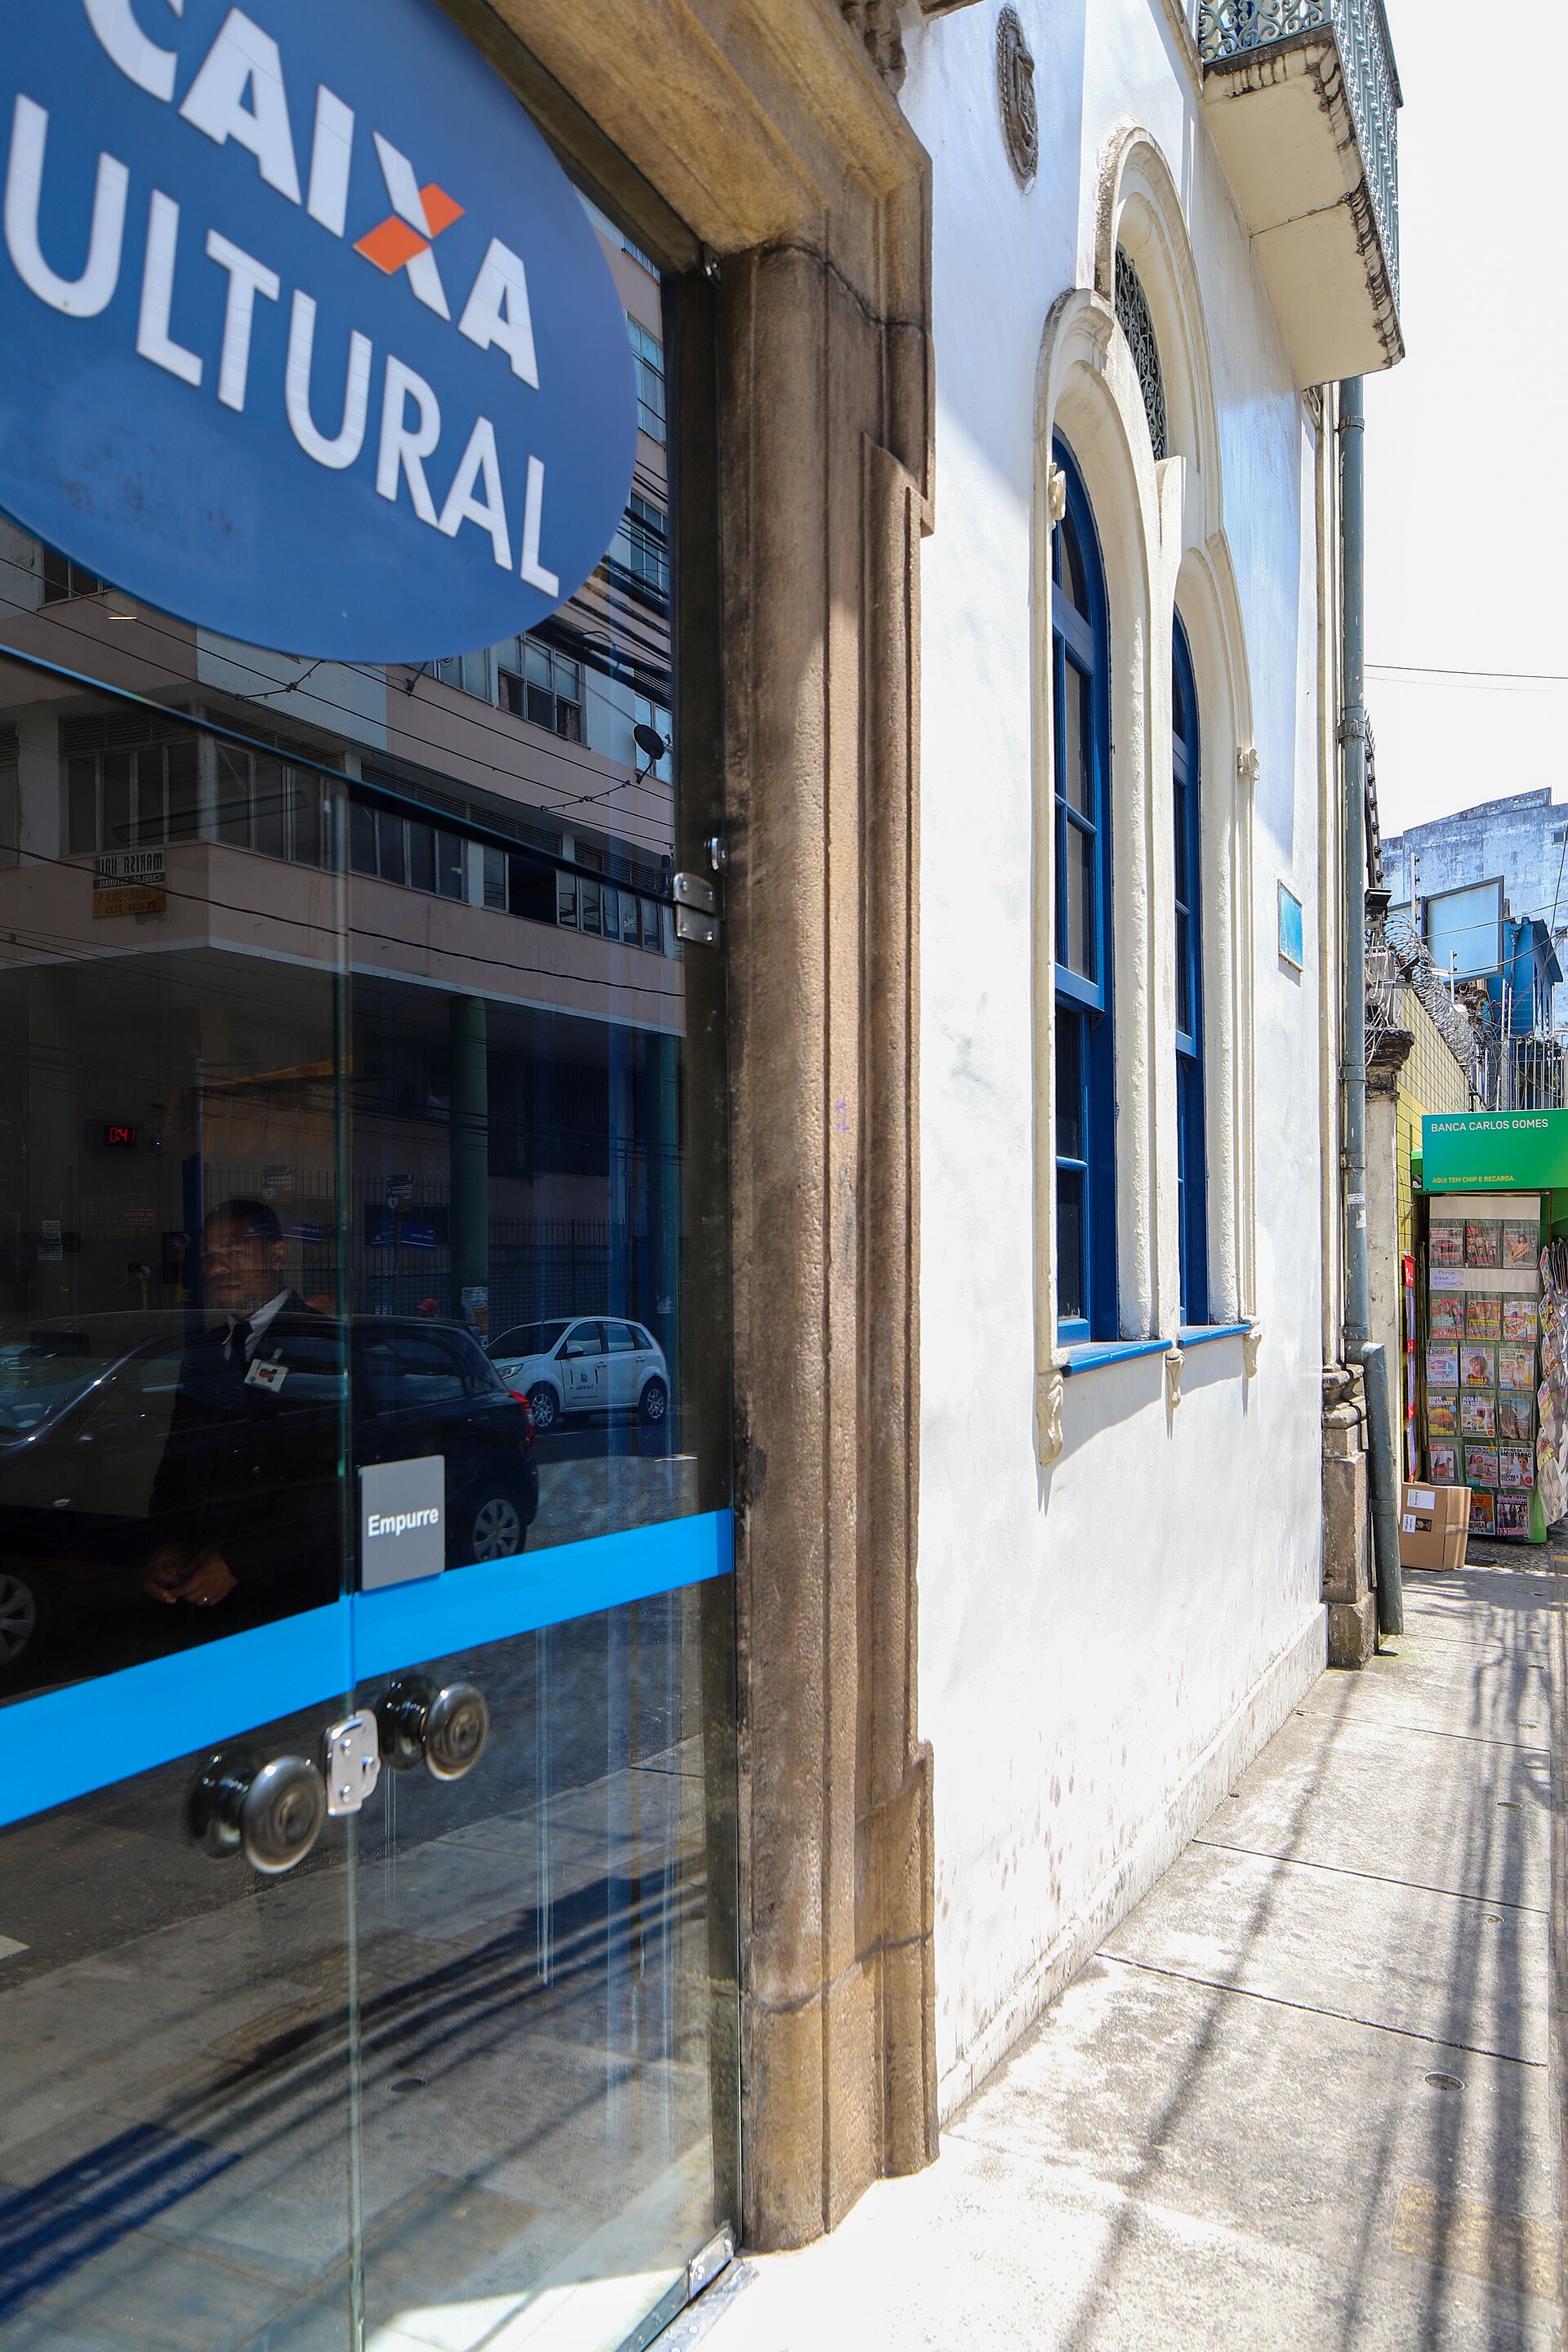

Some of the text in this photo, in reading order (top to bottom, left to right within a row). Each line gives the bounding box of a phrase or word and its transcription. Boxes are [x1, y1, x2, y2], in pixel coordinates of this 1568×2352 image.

[84, 0, 540, 390] CAIXA
[5, 93, 560, 599] ULTURAL
[1431, 1119, 1548, 1133] BANCA CARLOS GOMES
[368, 1507, 440, 1538] Empurre
